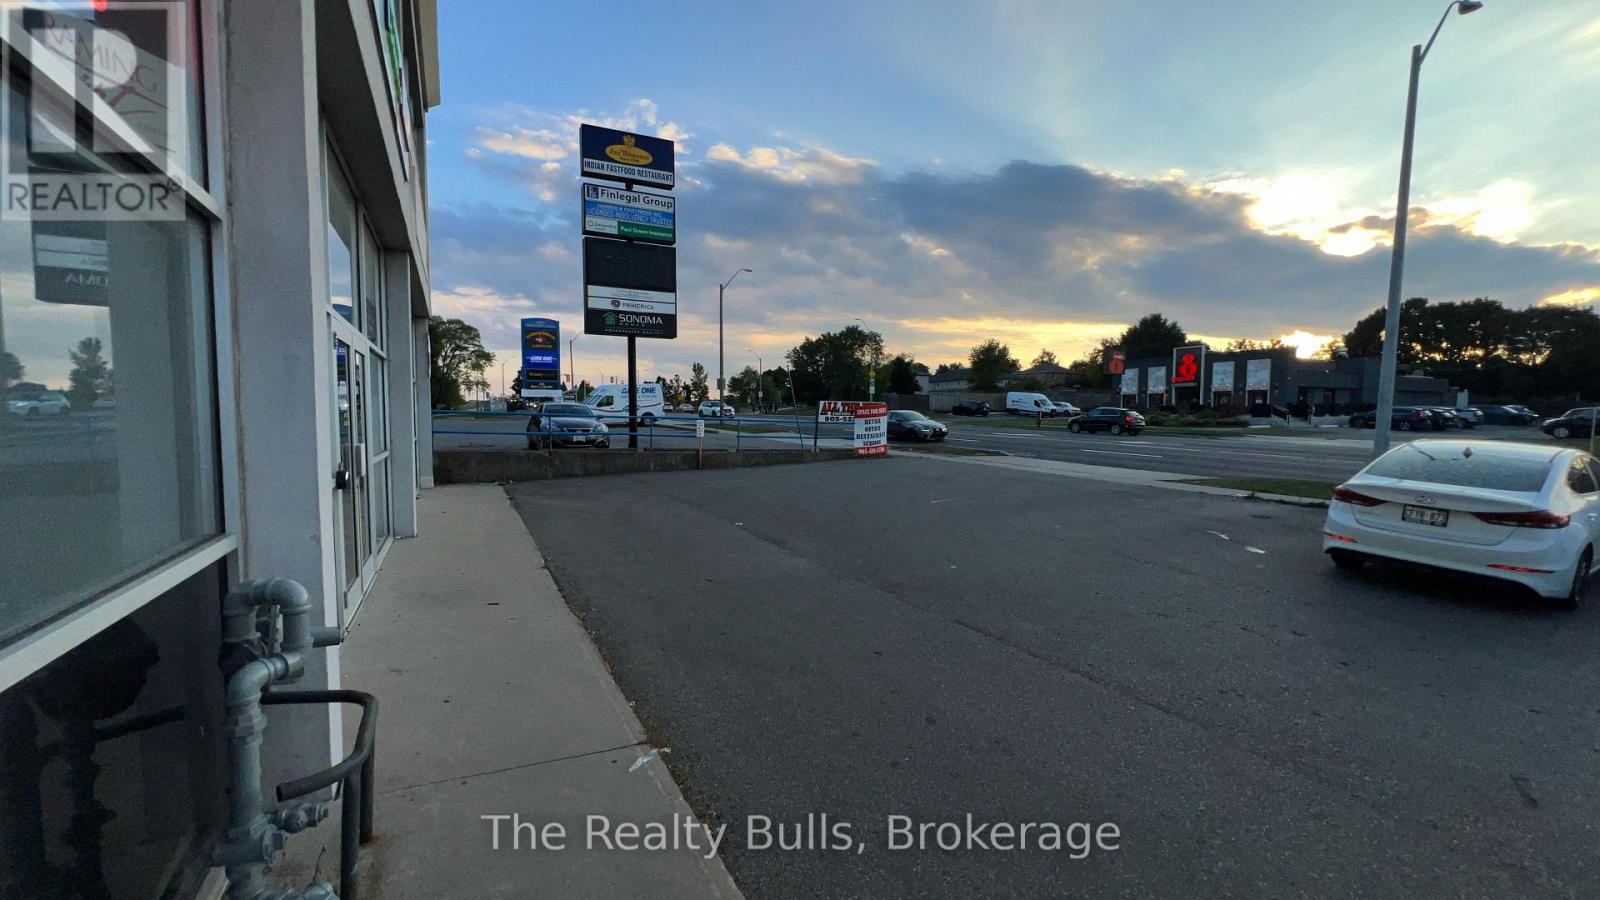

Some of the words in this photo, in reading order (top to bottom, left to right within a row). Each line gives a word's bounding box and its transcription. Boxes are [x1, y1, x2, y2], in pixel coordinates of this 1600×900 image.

[584, 160, 605, 171] INDIAN
[606, 164, 636, 176] FASTFOOD
[637, 169, 673, 182] RESTAURANT
[600, 188, 640, 203] Finlegal
[643, 196, 673, 209] Group
[648, 230, 673, 238] Insurance
[618, 313, 663, 325] SONOMA
